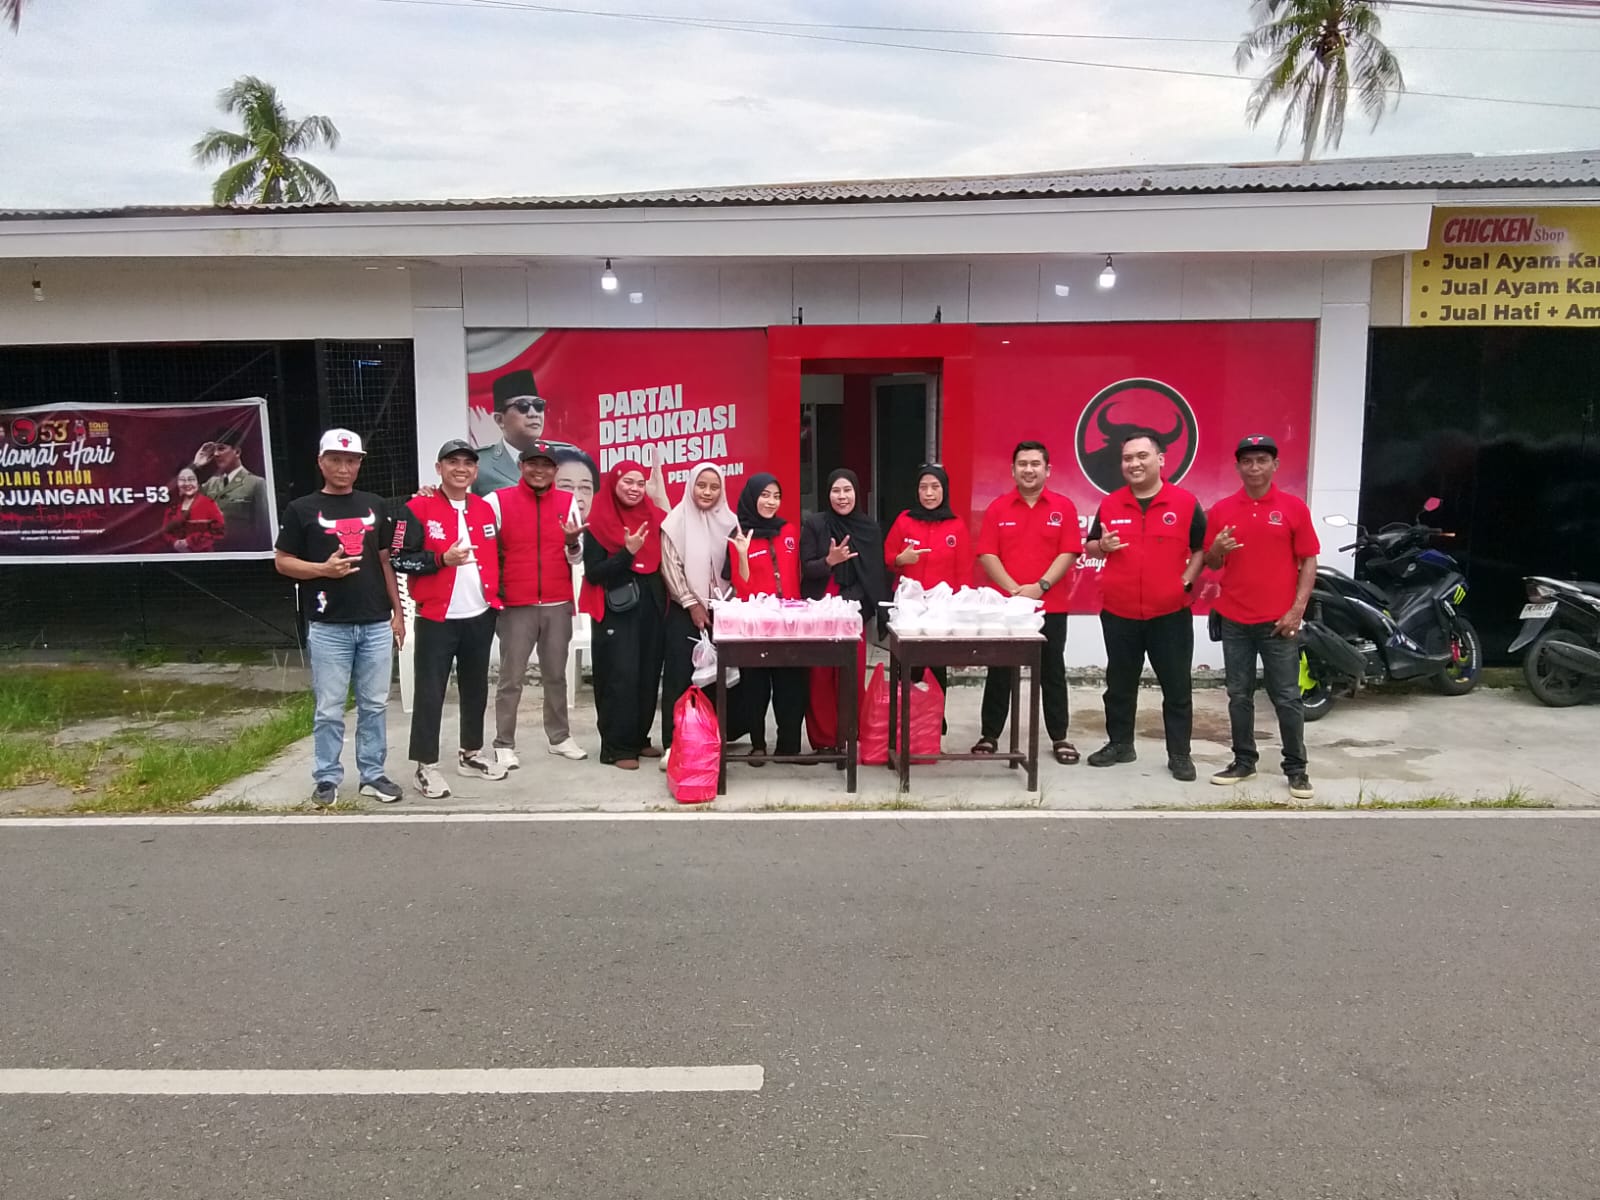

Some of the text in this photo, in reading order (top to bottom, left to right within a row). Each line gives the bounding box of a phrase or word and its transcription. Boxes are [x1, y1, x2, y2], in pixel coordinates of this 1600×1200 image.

[1443, 217, 1565, 243] CHICKEN Shop
[1442, 252, 1489, 270] Jual
[1496, 253, 1560, 273] Ayam
[1440, 278, 1488, 295] Jual
[1494, 278, 1559, 298] Ayam
[1439, 304, 1486, 321] Jual
[1494, 302, 1540, 320] Hati
[598, 384, 682, 419] PARTAI
[599, 404, 736, 445] DEMOKRASI
[63, 437, 115, 471] Hari
[47, 470, 92, 485] TAHUN
[108, 486, 171, 504] KE-53
